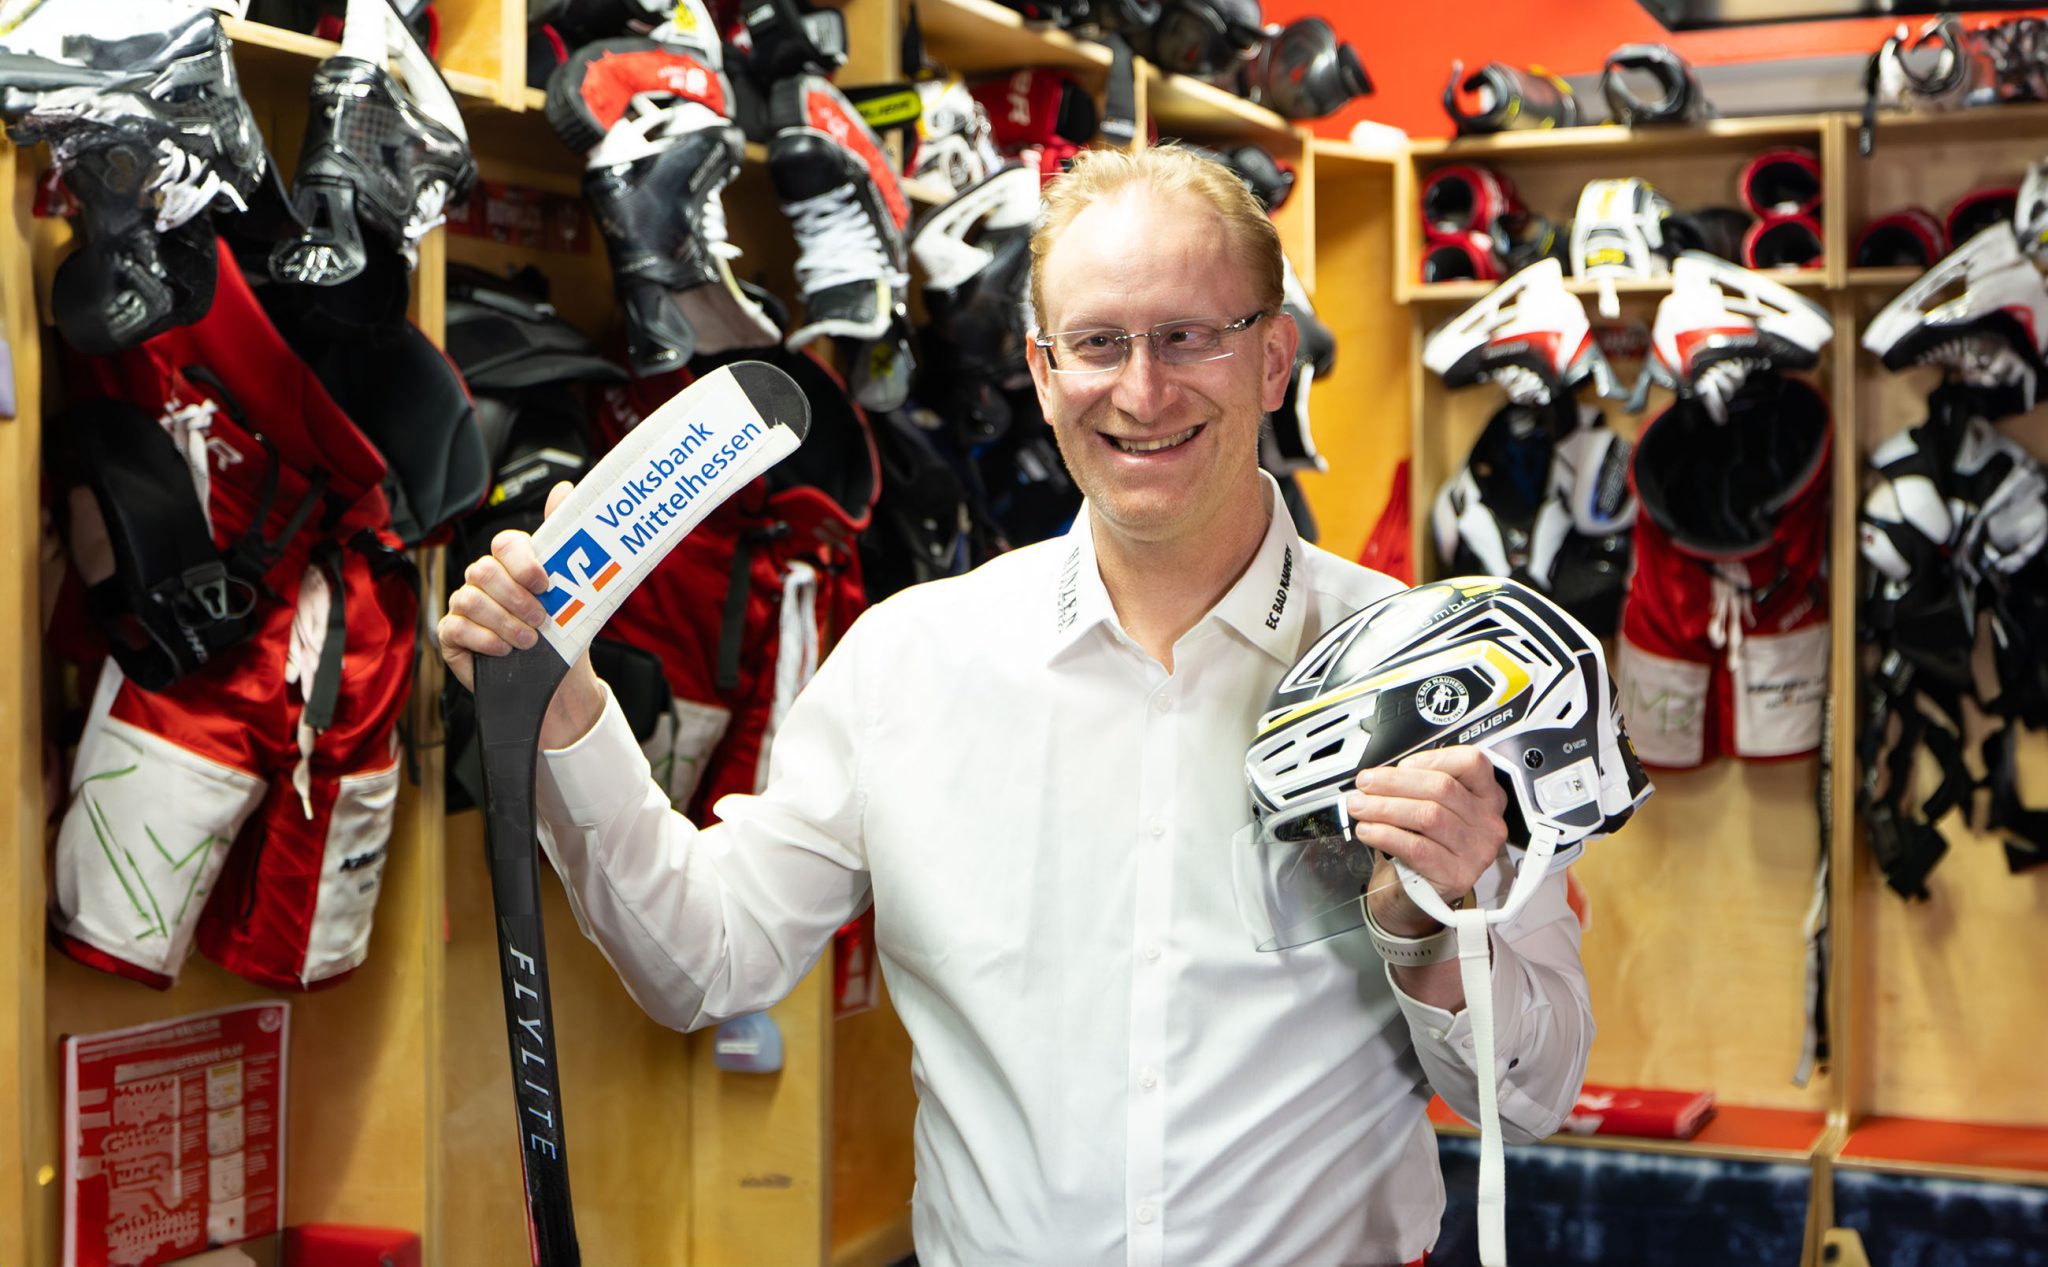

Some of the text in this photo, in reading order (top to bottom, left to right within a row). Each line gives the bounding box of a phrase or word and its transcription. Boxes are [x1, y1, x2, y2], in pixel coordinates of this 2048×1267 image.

[595, 421, 715, 529] Volksbank
[619, 420, 762, 556] Mittelhessen
[1272, 588, 1287, 616] BAD
[1265, 612, 1280, 631] EC
[1418, 677, 1467, 710] EC BAD NAUHEIM
[1432, 715, 1452, 723] SINCE
[1458, 707, 1514, 744] BAUER
[509, 943, 557, 1161] FLYLITE
